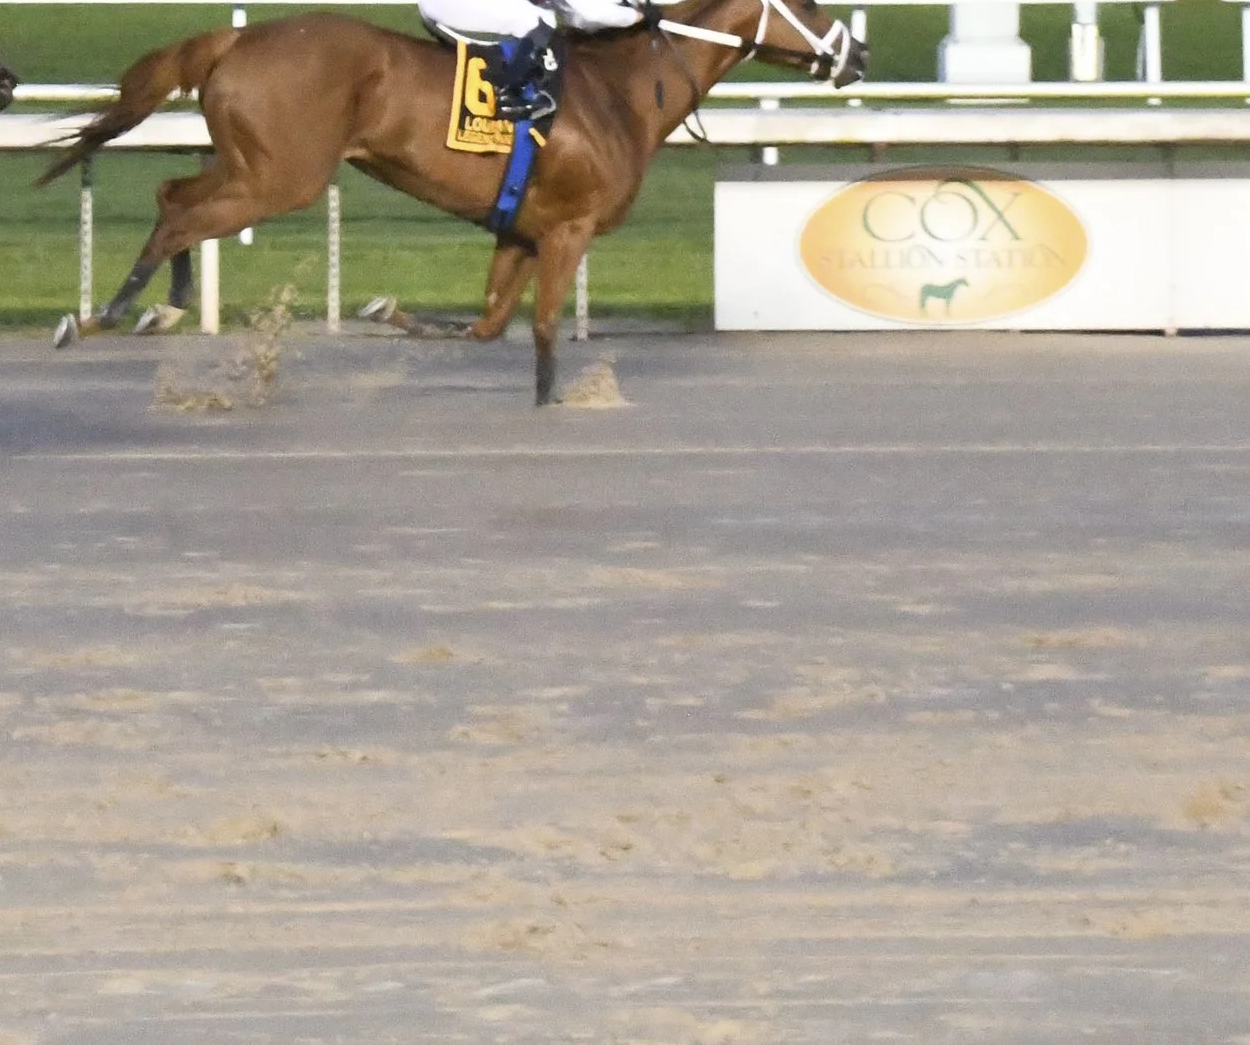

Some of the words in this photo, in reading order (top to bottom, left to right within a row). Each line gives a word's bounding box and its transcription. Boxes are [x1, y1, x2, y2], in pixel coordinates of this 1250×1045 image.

[464, 56, 496, 118] 6
[860, 177, 1024, 243] COX
[820, 244, 944, 270] STALLION
